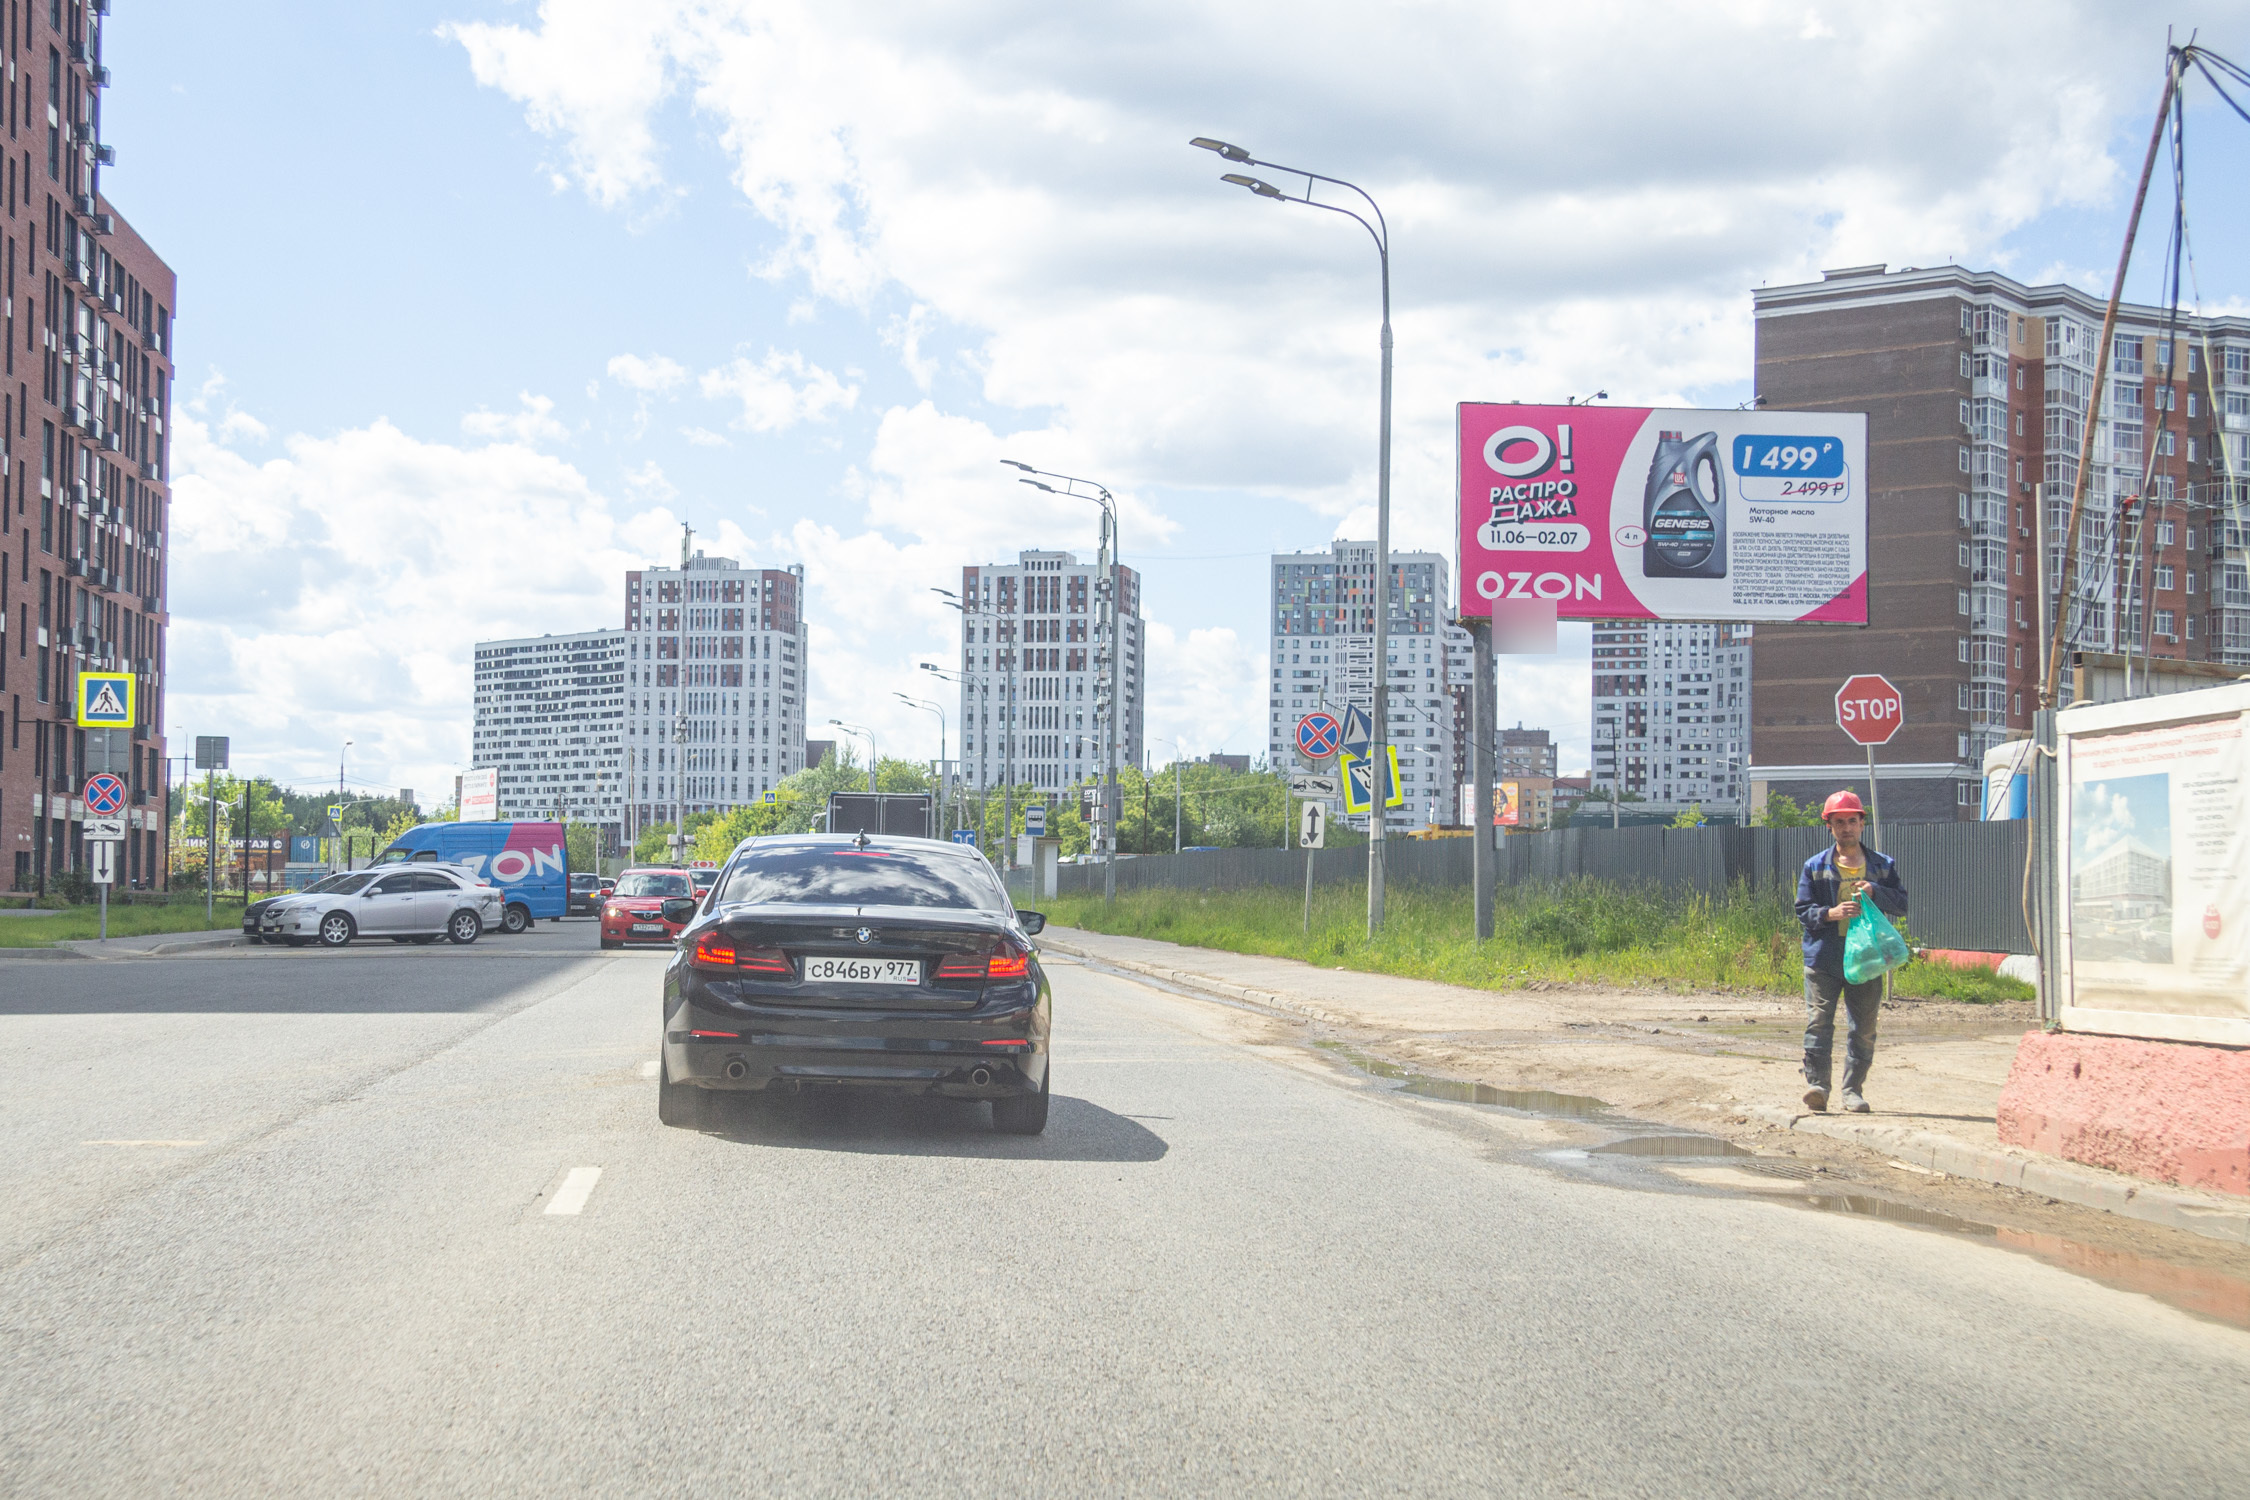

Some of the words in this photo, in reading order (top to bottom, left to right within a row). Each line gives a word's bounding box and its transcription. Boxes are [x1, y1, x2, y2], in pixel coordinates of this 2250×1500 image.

[1483, 424, 1574, 478] О!
[1743, 445, 1753, 469] 1
[1760, 445, 1818, 470] 499
[1489, 479, 1577, 504] РАСПРО
[1782, 481, 1793, 495] 2
[1798, 481, 1829, 496] 499
[1489, 498, 1575, 526] ДАЖА
[1749, 507, 1789, 516] Моторное
[1749, 516, 1775, 524] 5W-40
[1655, 518, 1710, 529] GENESIS
[1624, 532, 1630, 540] 4
[1476, 571, 1602, 601] OZON
[1842, 698, 1898, 721] STOP
[461, 844, 564, 885] ZON
[886, 961, 914, 976] 977
